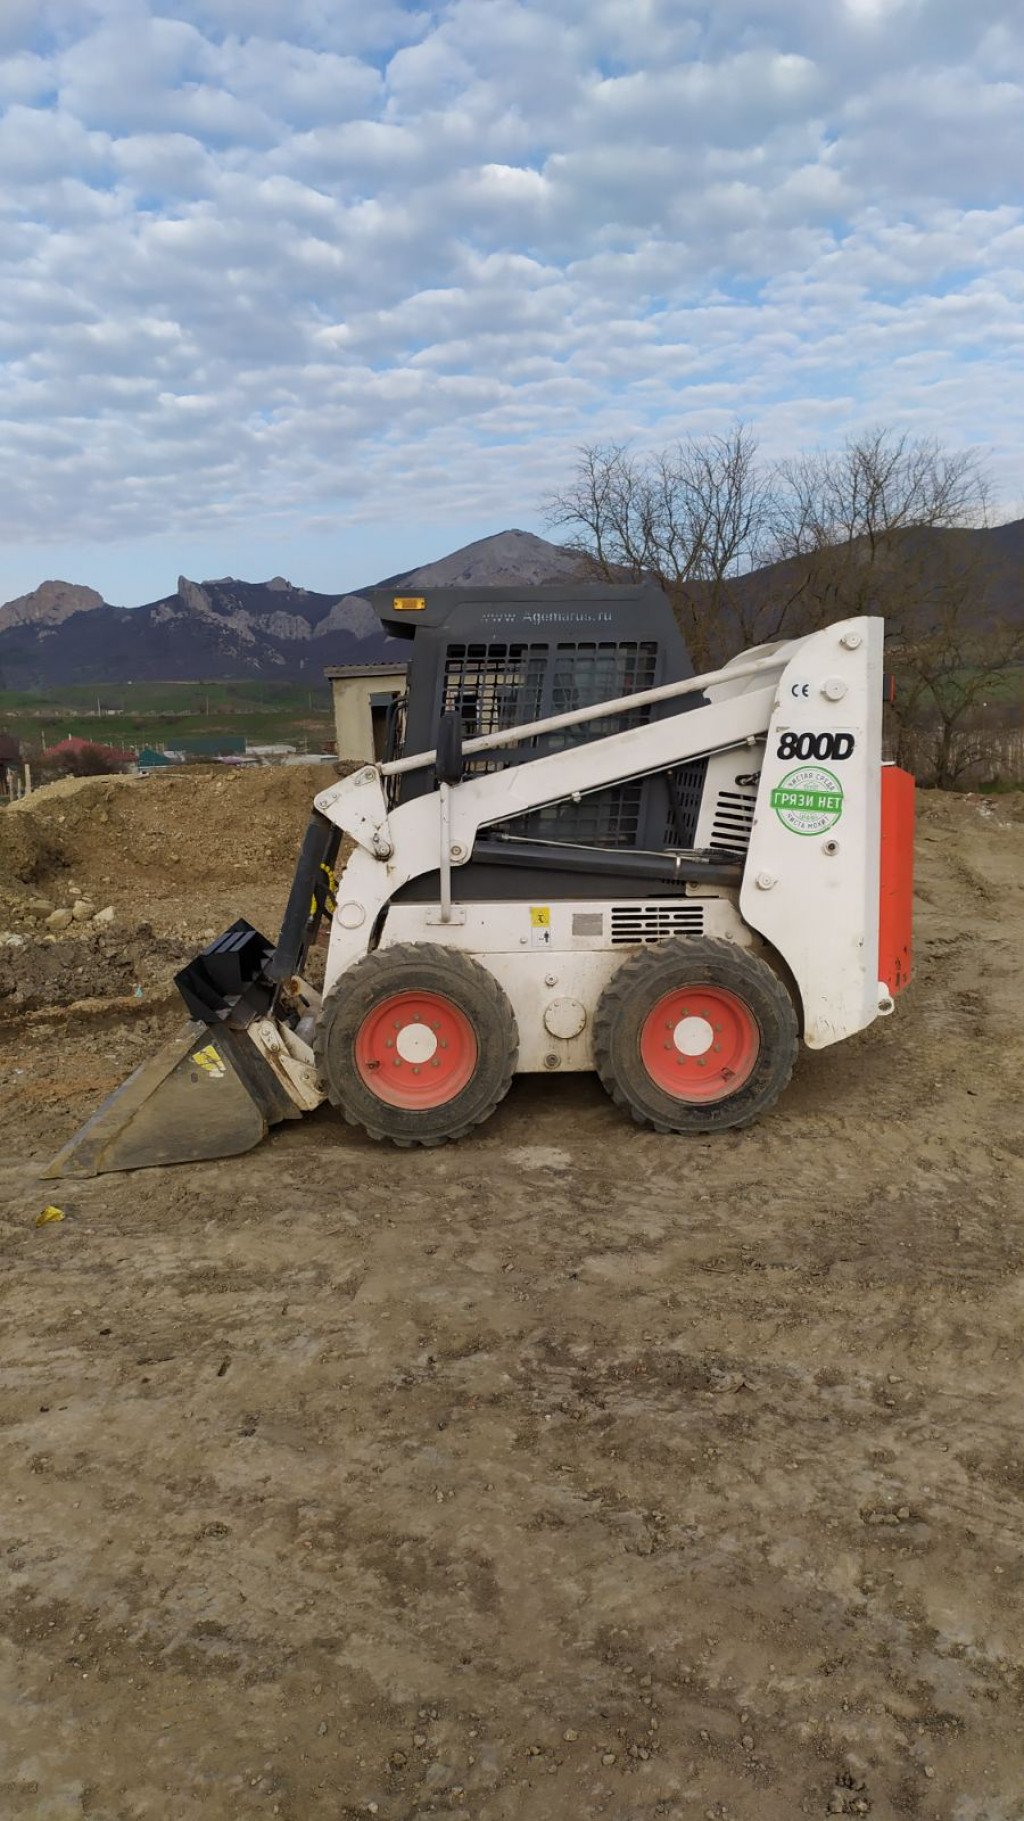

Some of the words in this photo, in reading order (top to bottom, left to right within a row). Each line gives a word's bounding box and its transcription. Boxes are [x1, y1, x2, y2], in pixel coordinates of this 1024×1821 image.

[776, 732, 856, 761] 800D
[774, 792, 814, 807] ГРЯЗИ
[817, 796, 841, 809] НЕТ
